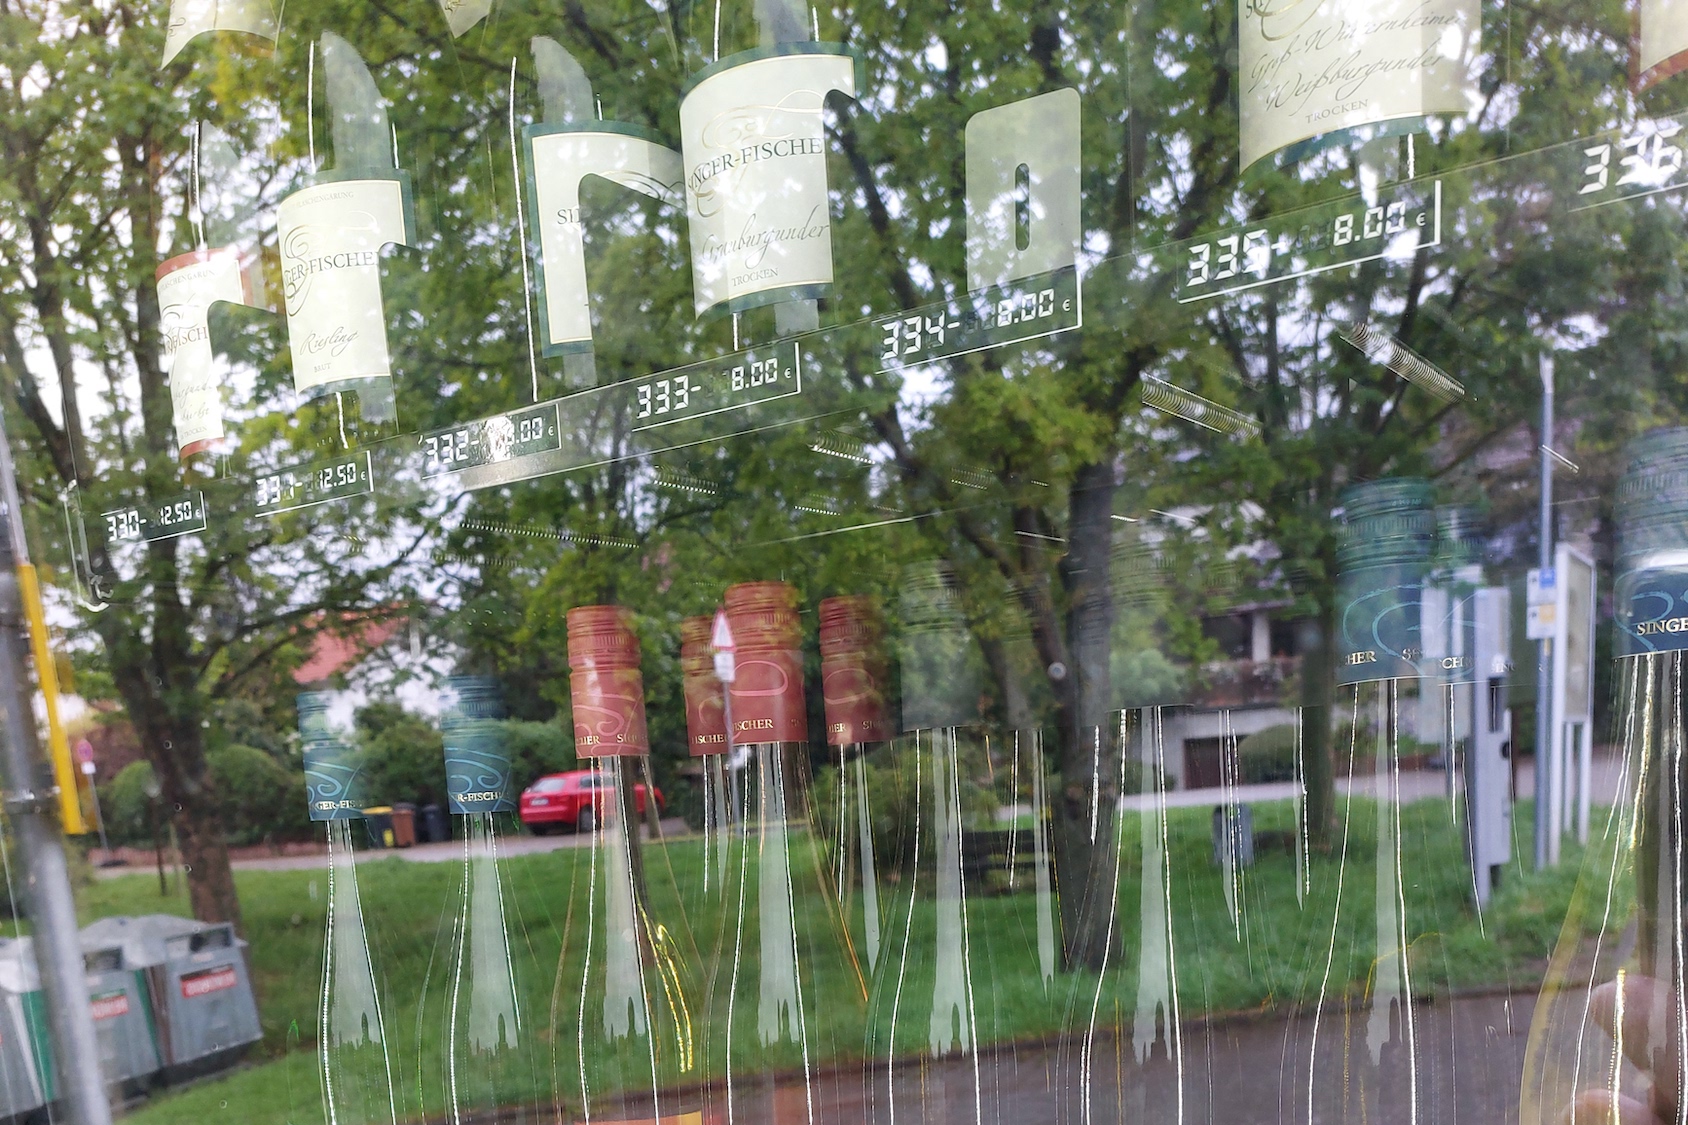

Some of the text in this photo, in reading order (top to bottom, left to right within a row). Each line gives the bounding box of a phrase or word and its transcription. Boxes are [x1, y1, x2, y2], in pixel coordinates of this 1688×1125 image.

[1305, 99, 1368, 124] TROCKEN
[1333, 201, 1406, 246] 8.00
[731, 268, 778, 287] TROCKEN
[300, 326, 359, 358] Riesling
[313, 362, 332, 373] BRUT
[731, 358, 778, 392] 8.00
[160, 501, 193, 525] 12.50
